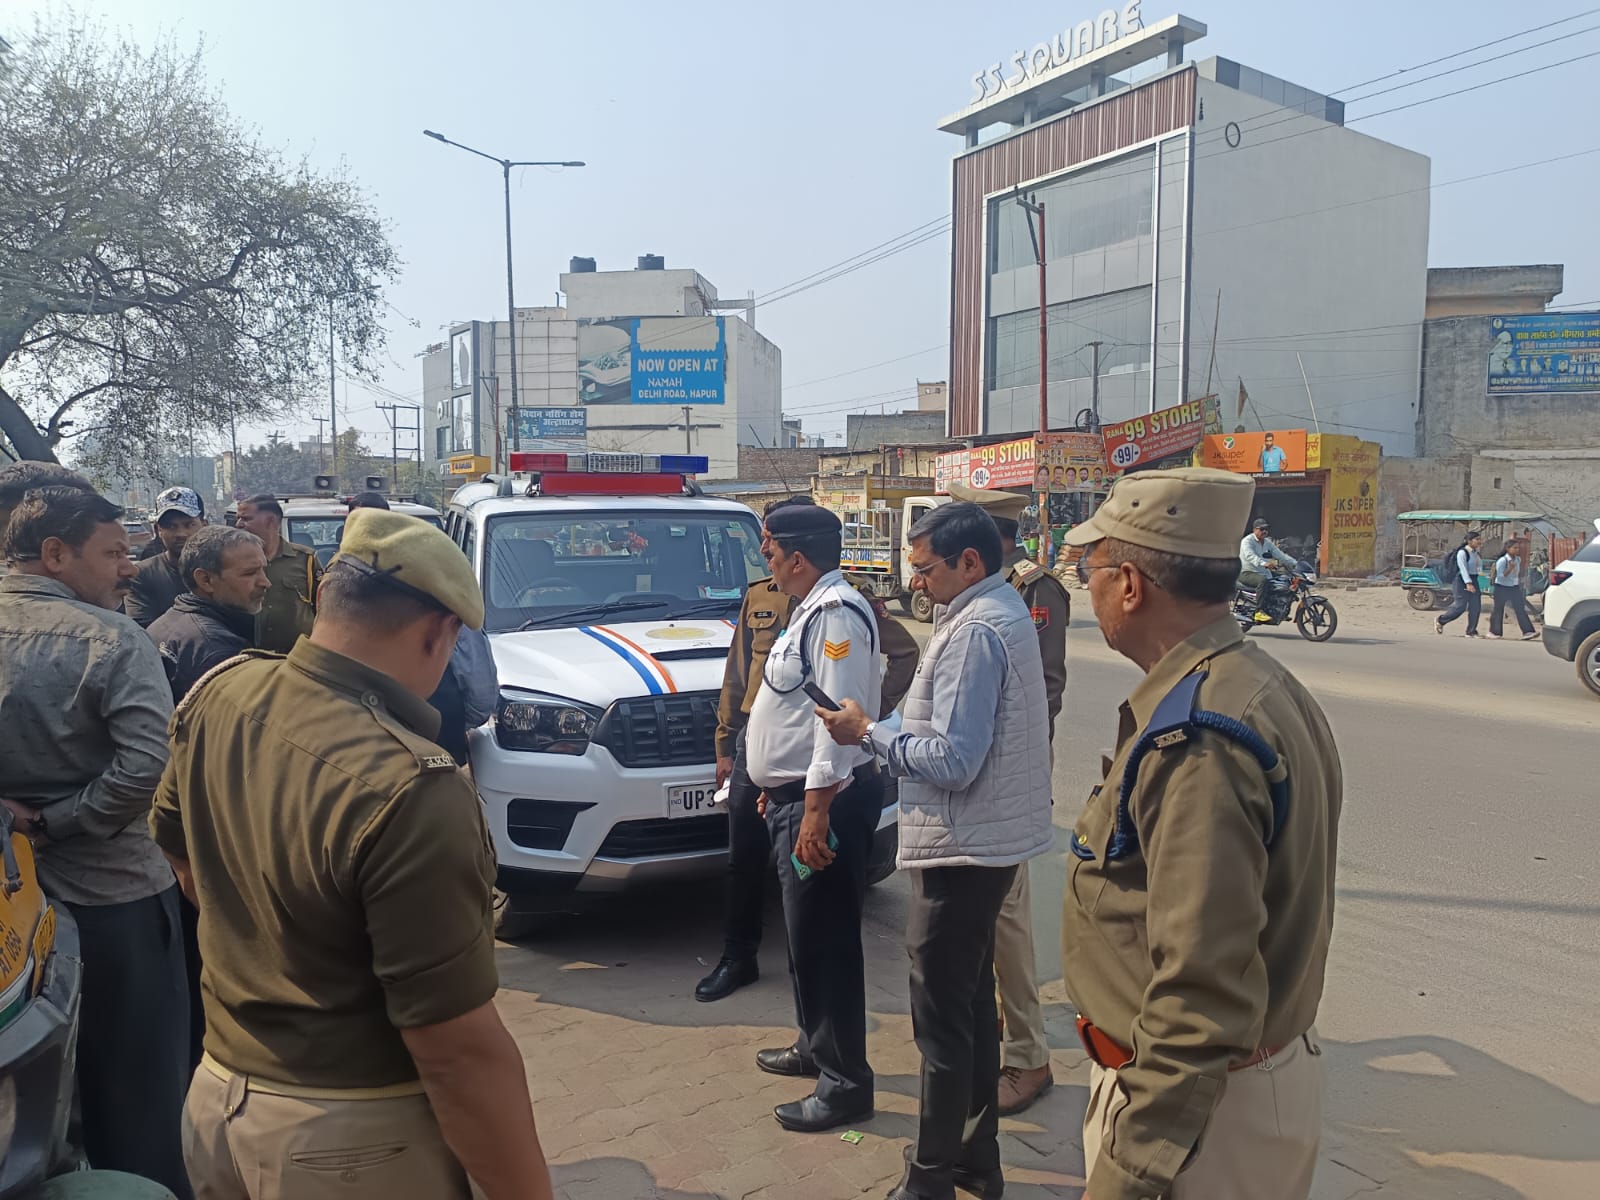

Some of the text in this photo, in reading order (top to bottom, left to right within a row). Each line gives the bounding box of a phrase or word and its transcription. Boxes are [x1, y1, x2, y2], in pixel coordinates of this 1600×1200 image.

[1009, 0, 1145, 88] SQUARE
[638, 358, 719, 372] NOW OPEN AT
[638, 389, 718, 400] DELHI ROAD, HAPUR
[1124, 418, 1146, 443] 99
[1150, 402, 1201, 434] STORE
[981, 447, 996, 467] 99
[1334, 498, 1346, 511] JK
[1333, 512, 1374, 528] STRONG
